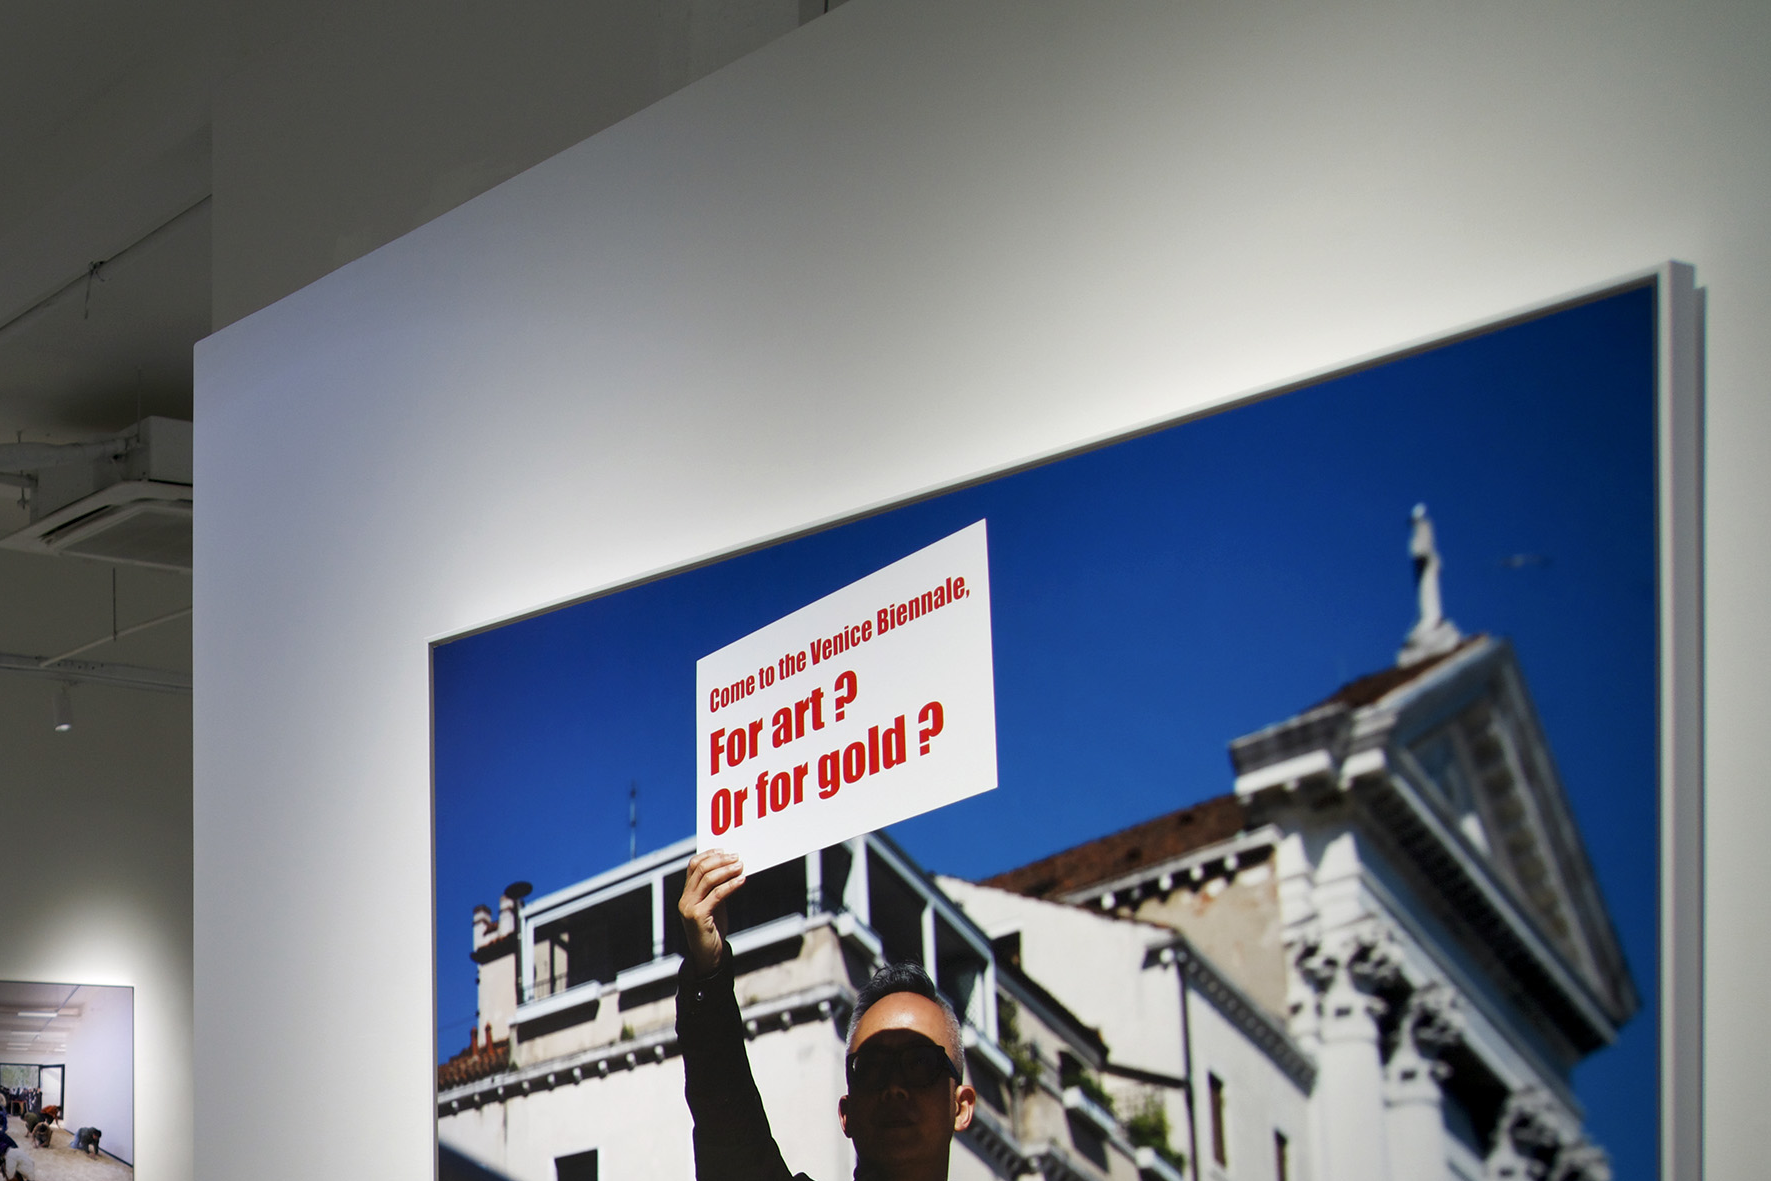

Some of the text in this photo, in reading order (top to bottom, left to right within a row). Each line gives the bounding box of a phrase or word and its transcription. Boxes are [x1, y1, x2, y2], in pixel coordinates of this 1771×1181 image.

[710, 576, 971, 713] Come to the Venice Biennale,
[710, 670, 858, 776] For art ?
[711, 701, 944, 836] Or for gold ?
